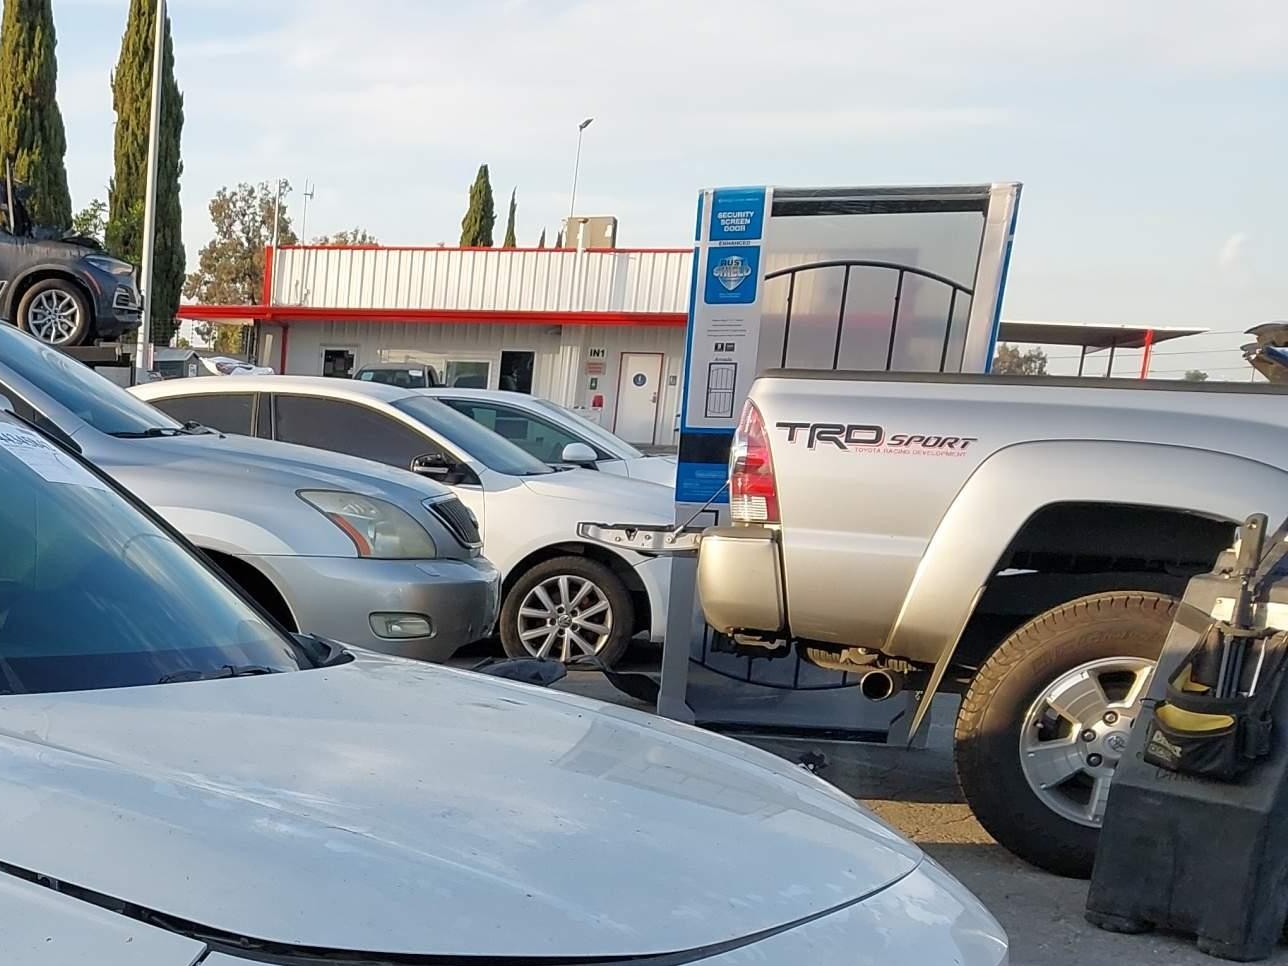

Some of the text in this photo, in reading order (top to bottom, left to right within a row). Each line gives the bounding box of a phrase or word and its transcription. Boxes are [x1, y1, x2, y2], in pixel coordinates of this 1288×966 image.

[717, 211, 754, 219] SECURITY
[721, 218, 751, 226] SCREEN
[589, 348, 606, 358] IN1
[775, 422, 979, 451] TRD SPORT
